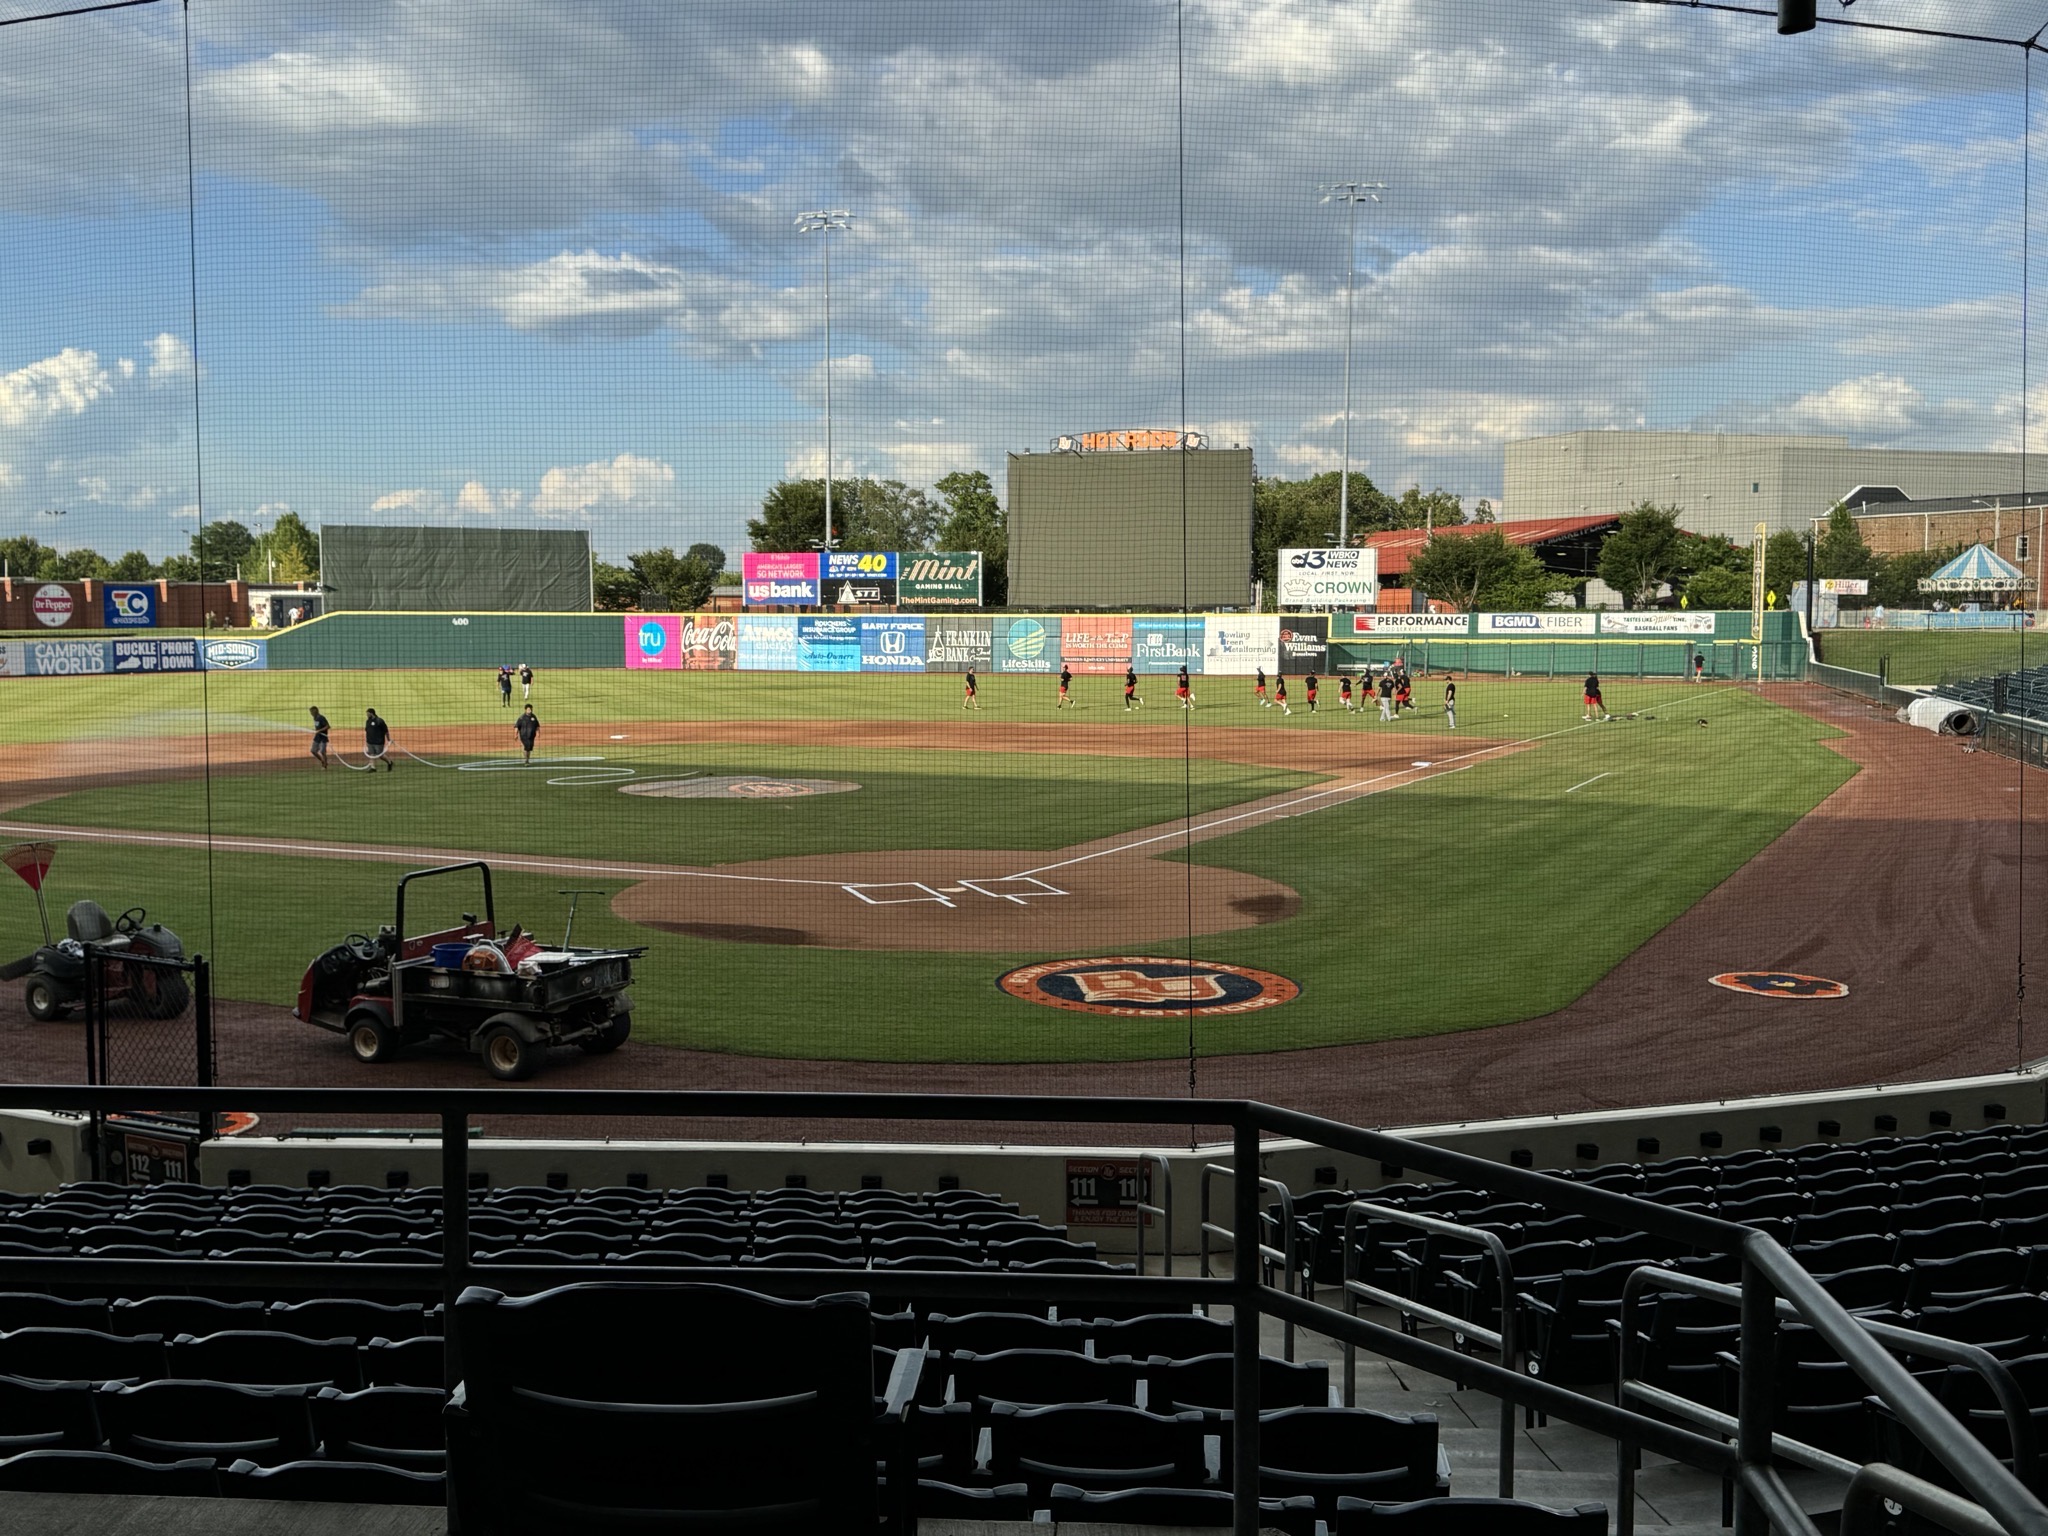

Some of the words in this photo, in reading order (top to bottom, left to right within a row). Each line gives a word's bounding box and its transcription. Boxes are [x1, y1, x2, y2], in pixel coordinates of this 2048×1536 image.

[1082, 432, 1120, 448] HOT
[1125, 432, 1177, 448] RODS
[1302, 551, 1327, 569] 13
[1329, 551, 1358, 559] WBKO
[829, 555, 859, 565] NEWS
[857, 554, 887, 572] 40
[757, 570, 767, 578] 5G
[768, 570, 805, 578] NETWORK
[900, 567, 911, 580] THE
[908, 559, 978, 581] Mint
[1314, 582, 1372, 594] CROWN
[1835, 580, 1859, 588] Hiller
[35, 600, 45, 609] Dr
[45, 599, 71, 611] Pepper
[901, 597, 977, 605] TheMintGaming.com
[452, 617, 469, 626] 400
[1378, 616, 1468, 626] PERFORMANCE
[1495, 616, 1537, 627] BGMU
[1546, 617, 1583, 627] FIBER
[639, 629, 660, 647] tru
[682, 621, 737, 652] Coca-Cola
[946, 631, 992, 646] FRANKLIN
[1065, 632, 1090, 643] LIFE
[1218, 631, 1250, 640] Bowling
[1291, 632, 1318, 642] Evan
[35, 643, 104, 658] CAMPING
[116, 642, 156, 656] BUCKLE
[161, 642, 195, 654] PHONE
[208, 643, 255, 658] MID-SOUTH
[1136, 643, 1201, 658] FirstBank
[1223, 646, 1276, 654] Metalforming
[1284, 642, 1327, 651] Williams
[804, 651, 854, 660] Auto-Owners
[862, 656, 925, 665] HONDA
[946, 647, 969, 662] BANK
[36, 658, 104, 674] WORLD
[142, 656, 157, 669] UP
[162, 655, 194, 668] DOWN
[1002, 659, 1051, 668] LifeSkills
[1008, 958, 1113, 983] BOWLING
[1109, 1008, 1189, 1017] HOT
[1200, 996, 1280, 1014] RODS
[130, 1153, 150, 1173] 112
[163, 1159, 182, 1179] 111
[1119, 1166, 1151, 1174] SECTN
[1070, 1178, 1096, 1196] 111
